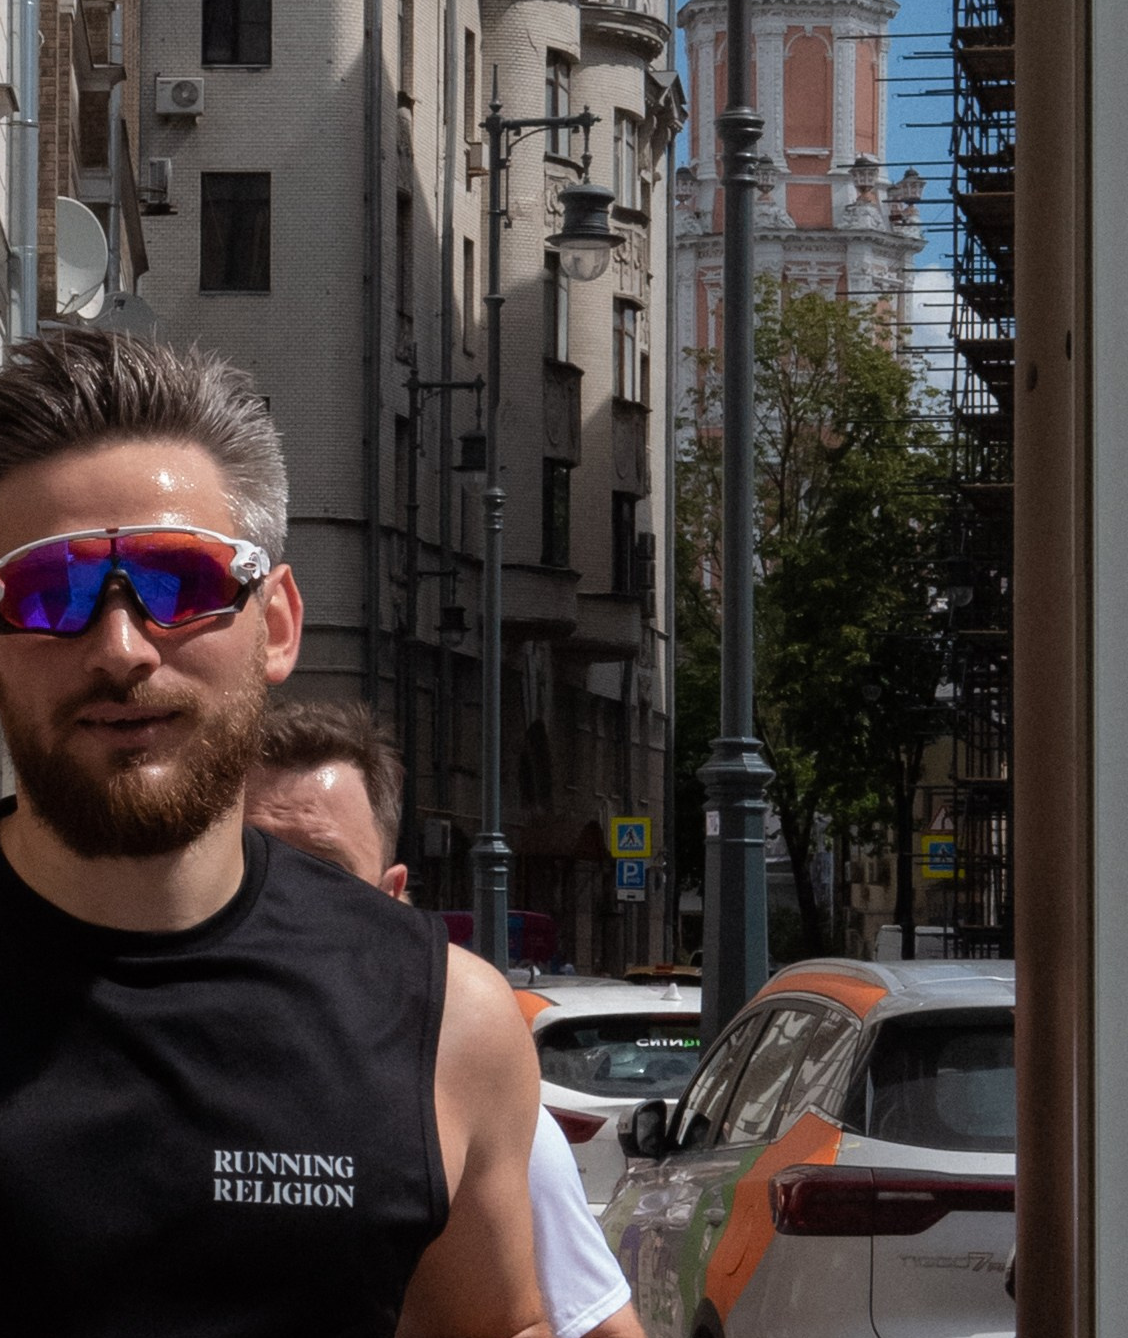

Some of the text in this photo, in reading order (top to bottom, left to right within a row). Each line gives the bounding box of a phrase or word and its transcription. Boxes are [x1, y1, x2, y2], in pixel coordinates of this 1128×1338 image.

[623, 862, 639, 884] P
[214, 1149, 354, 1178] RUNNING
[213, 1178, 355, 1208] RELIGION
